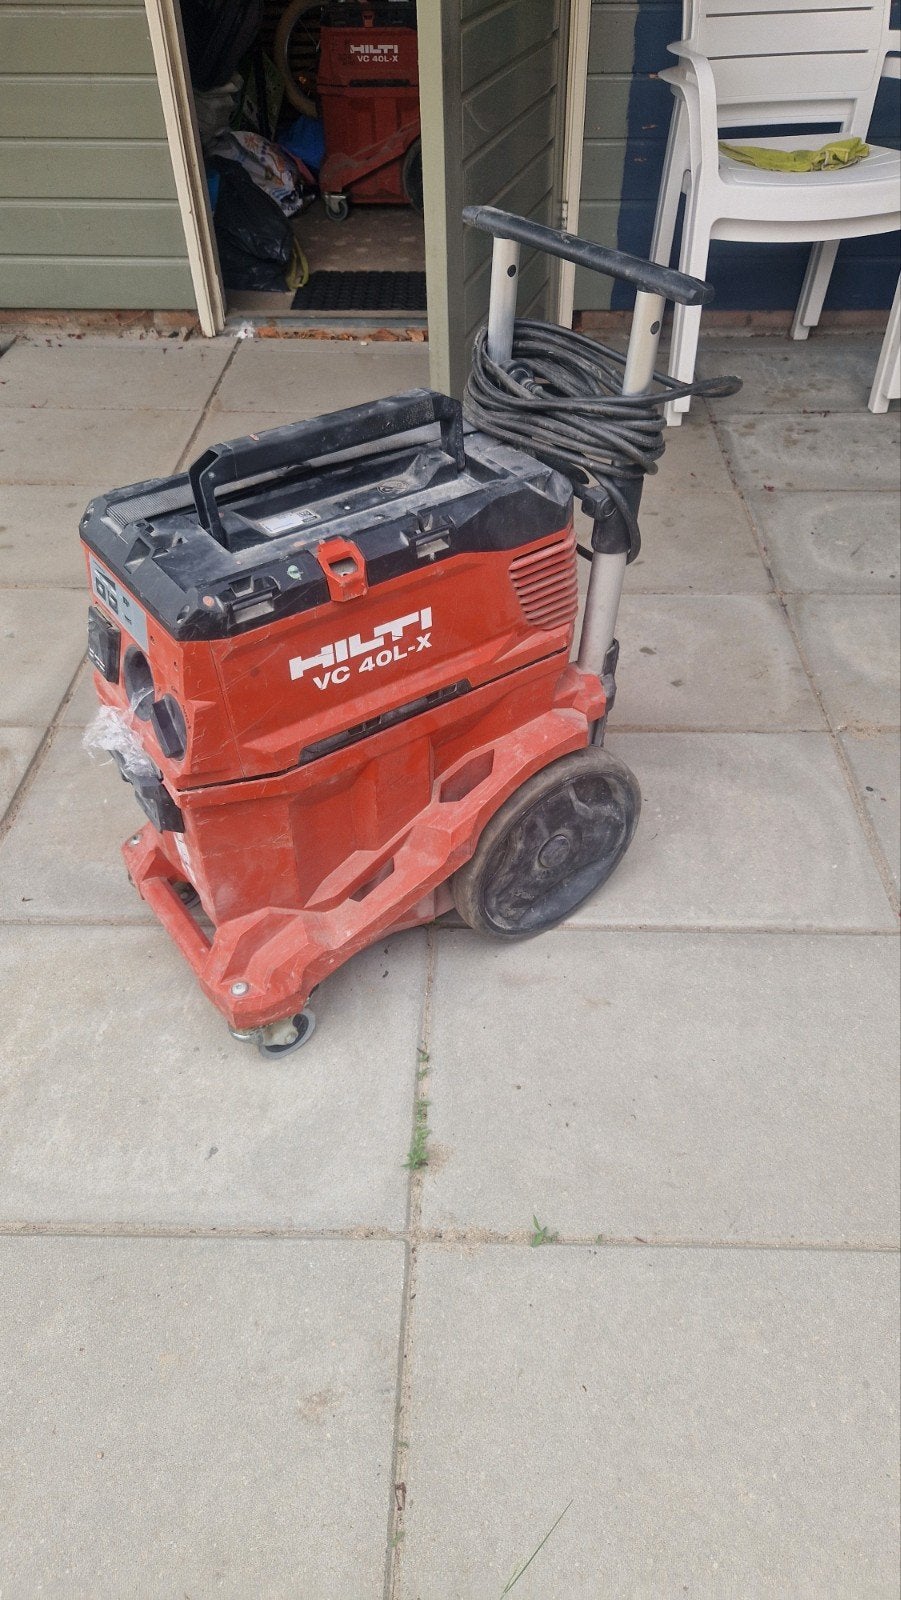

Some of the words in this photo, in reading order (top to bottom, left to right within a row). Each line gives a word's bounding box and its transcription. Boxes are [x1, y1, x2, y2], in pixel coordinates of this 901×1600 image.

[350, 45, 398, 53] HILTI
[289, 606, 432, 681] HILTI
[313, 666, 350, 690] VC
[358, 632, 432, 673] 40L-X
